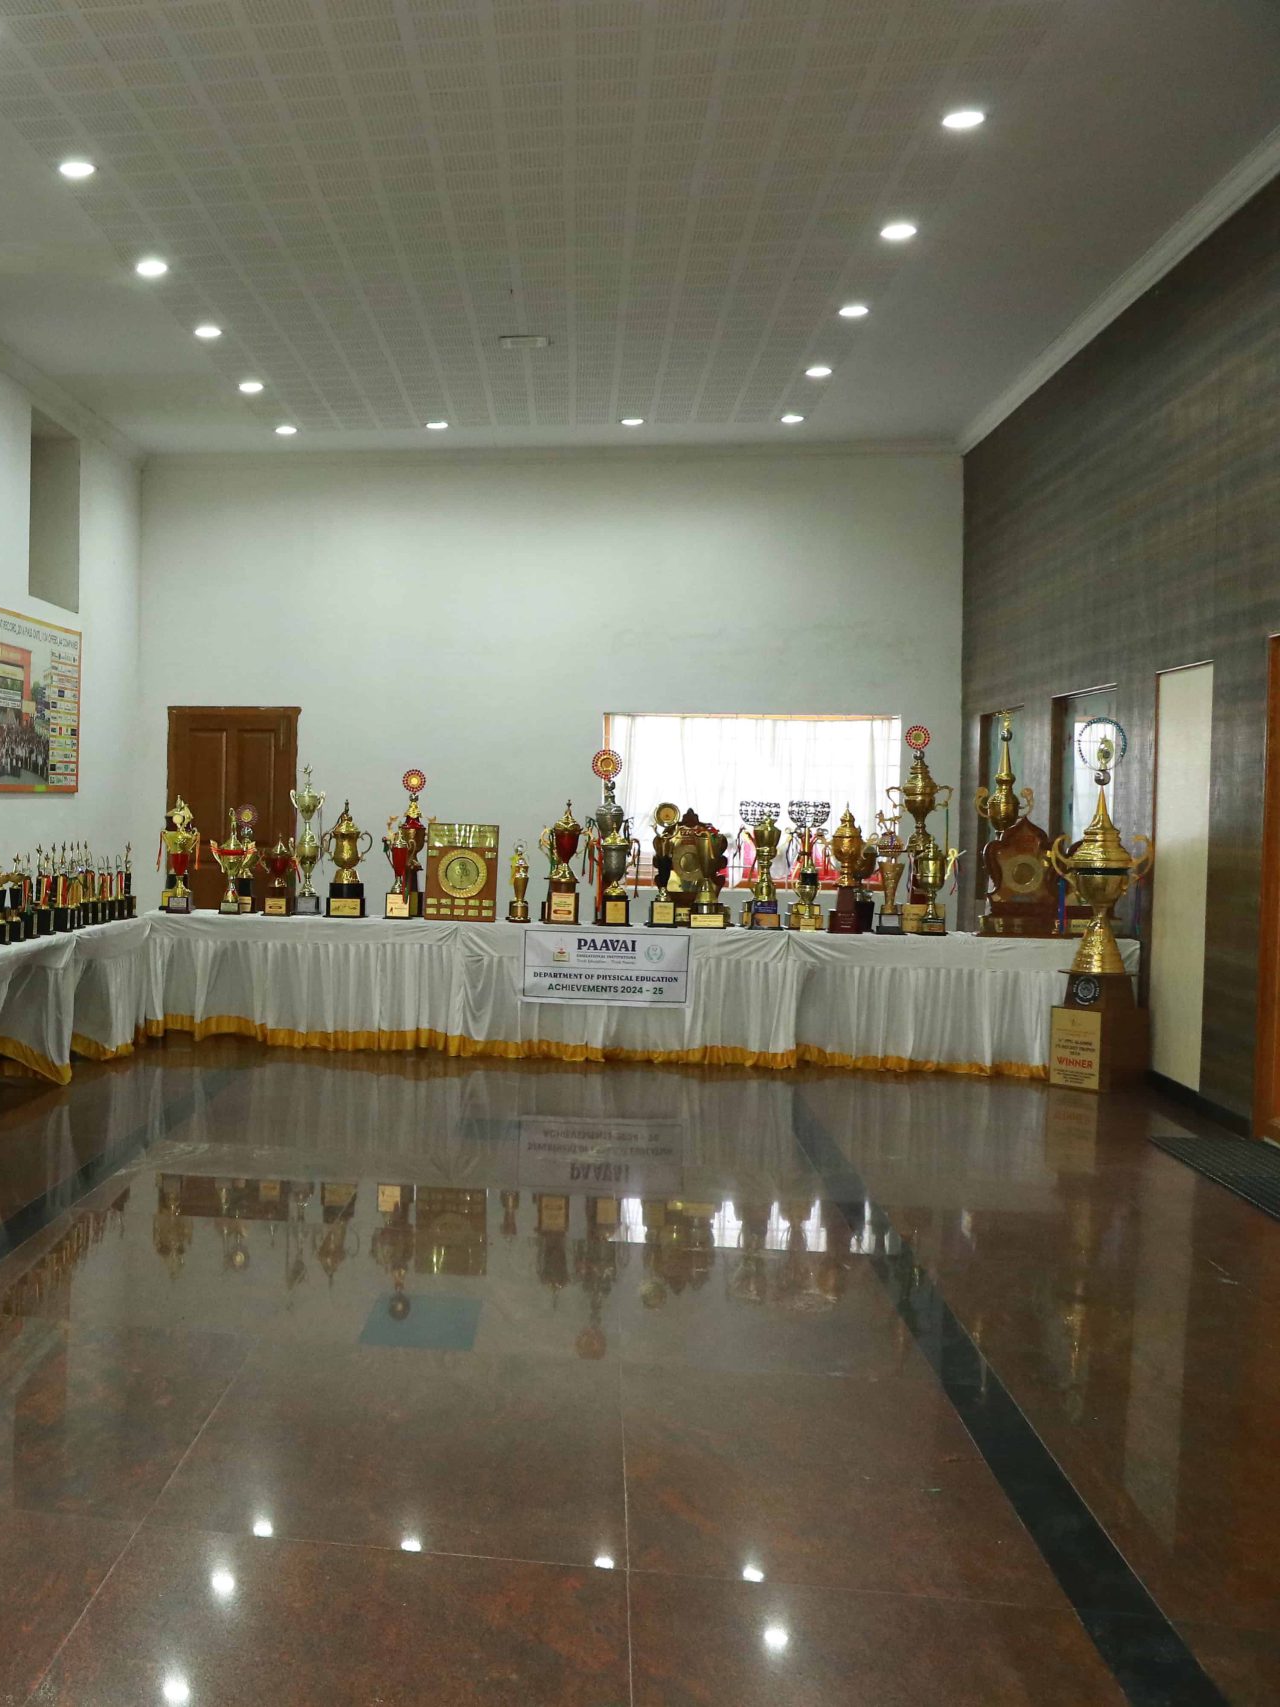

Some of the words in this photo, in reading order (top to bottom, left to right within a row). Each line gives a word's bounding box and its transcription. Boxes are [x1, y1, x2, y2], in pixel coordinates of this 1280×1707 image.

[577, 939, 637, 952] PAAVAI
[533, 972, 582, 980] DEPARTMENT
[597, 974, 634, 982] PHYSICAL
[548, 983, 618, 993] ACHIEVEMENTS
[620, 986, 643, 994] 2024
[1057, 1056, 1093, 1069] WINNER
